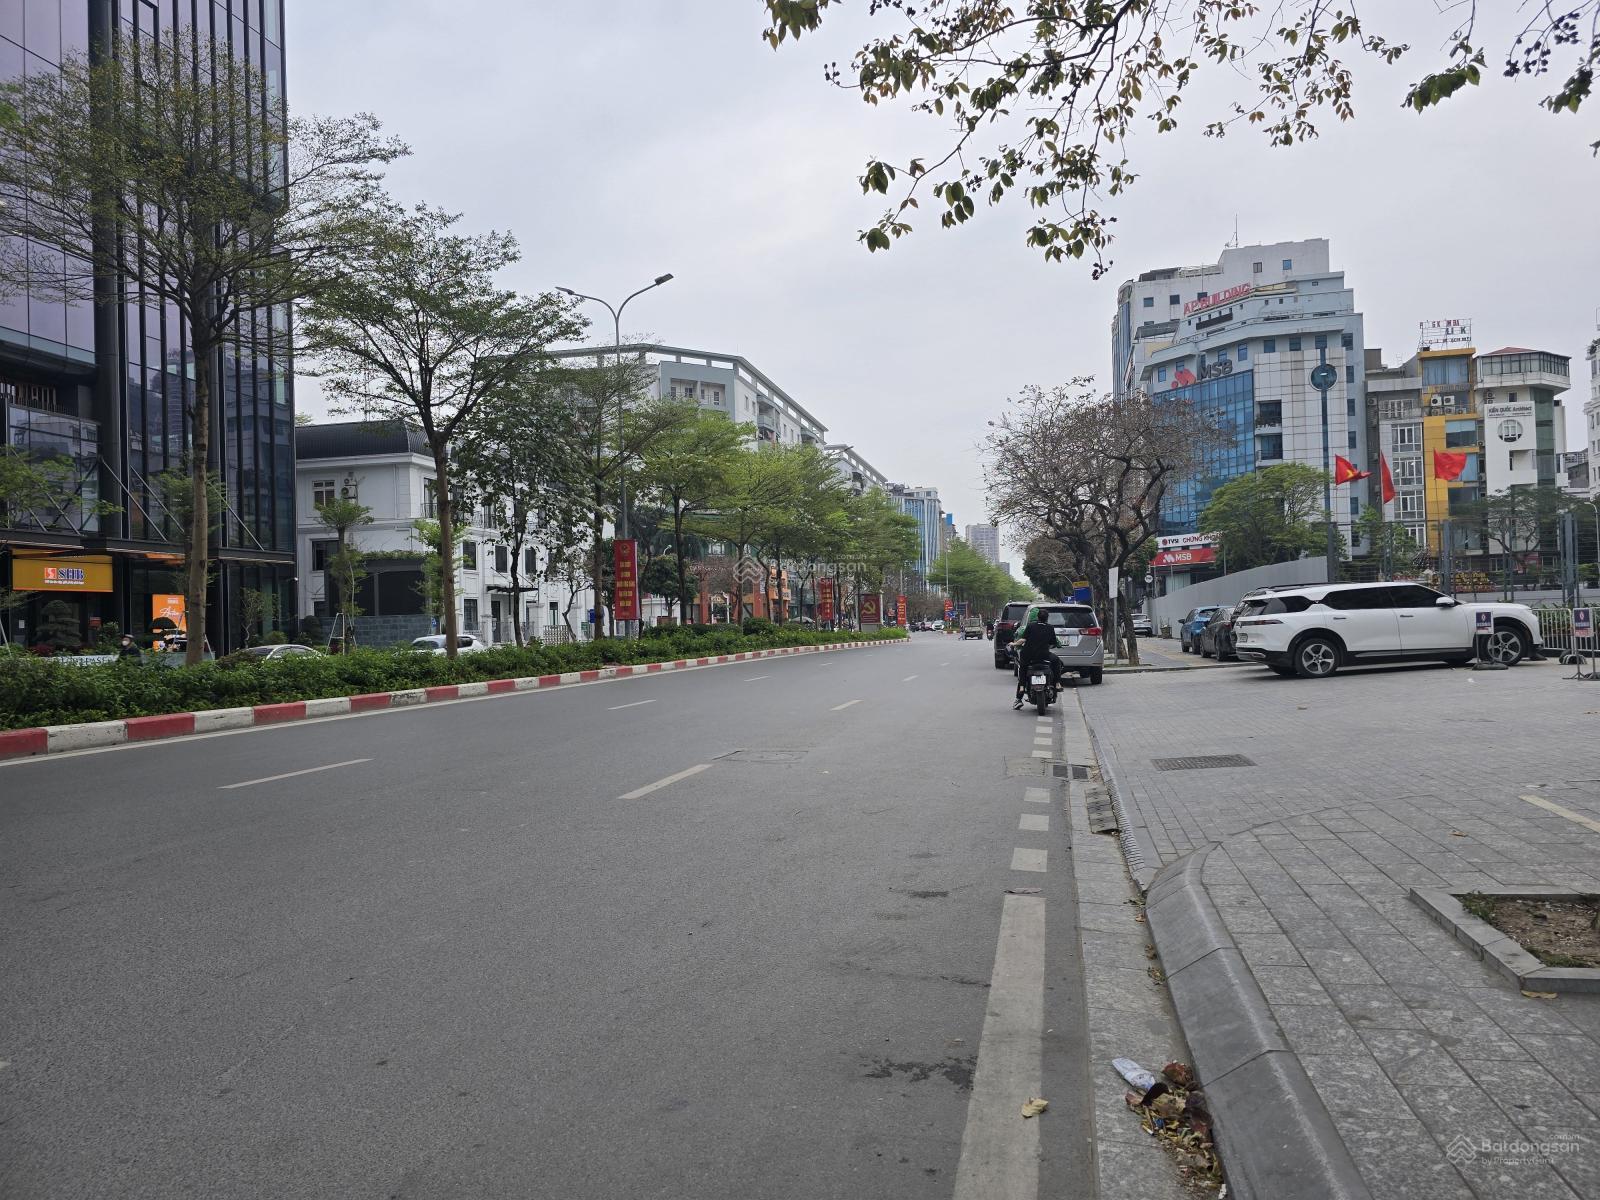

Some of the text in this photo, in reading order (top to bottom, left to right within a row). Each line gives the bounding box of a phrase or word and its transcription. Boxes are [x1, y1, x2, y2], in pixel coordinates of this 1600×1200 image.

[1197, 359, 1233, 381] MSB
[1175, 552, 1192, 562] MSB
[58, 568, 85, 580] SHB
